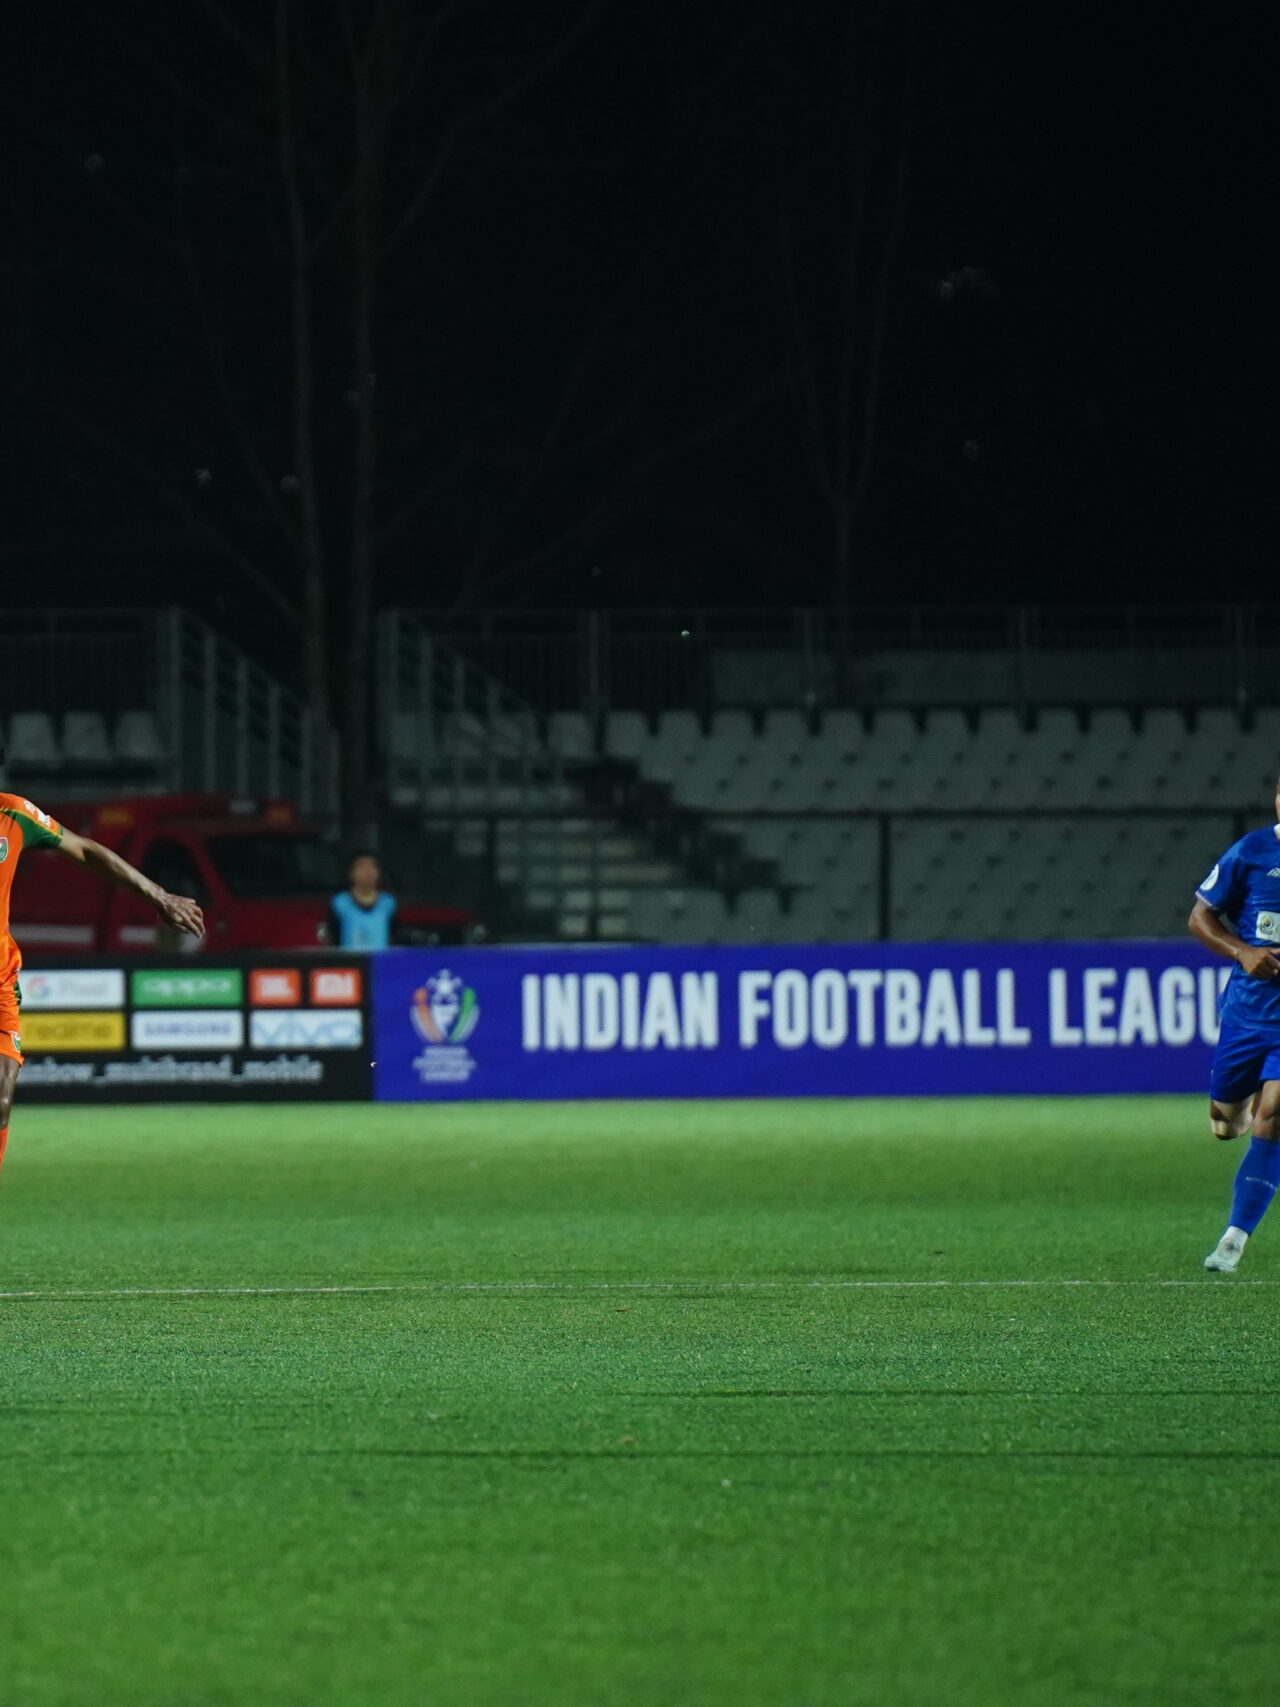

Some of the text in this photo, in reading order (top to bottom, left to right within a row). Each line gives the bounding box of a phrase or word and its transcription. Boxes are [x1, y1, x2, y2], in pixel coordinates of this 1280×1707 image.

[522, 966, 1231, 1050] INDIAN FOOTBALL LEAGU
